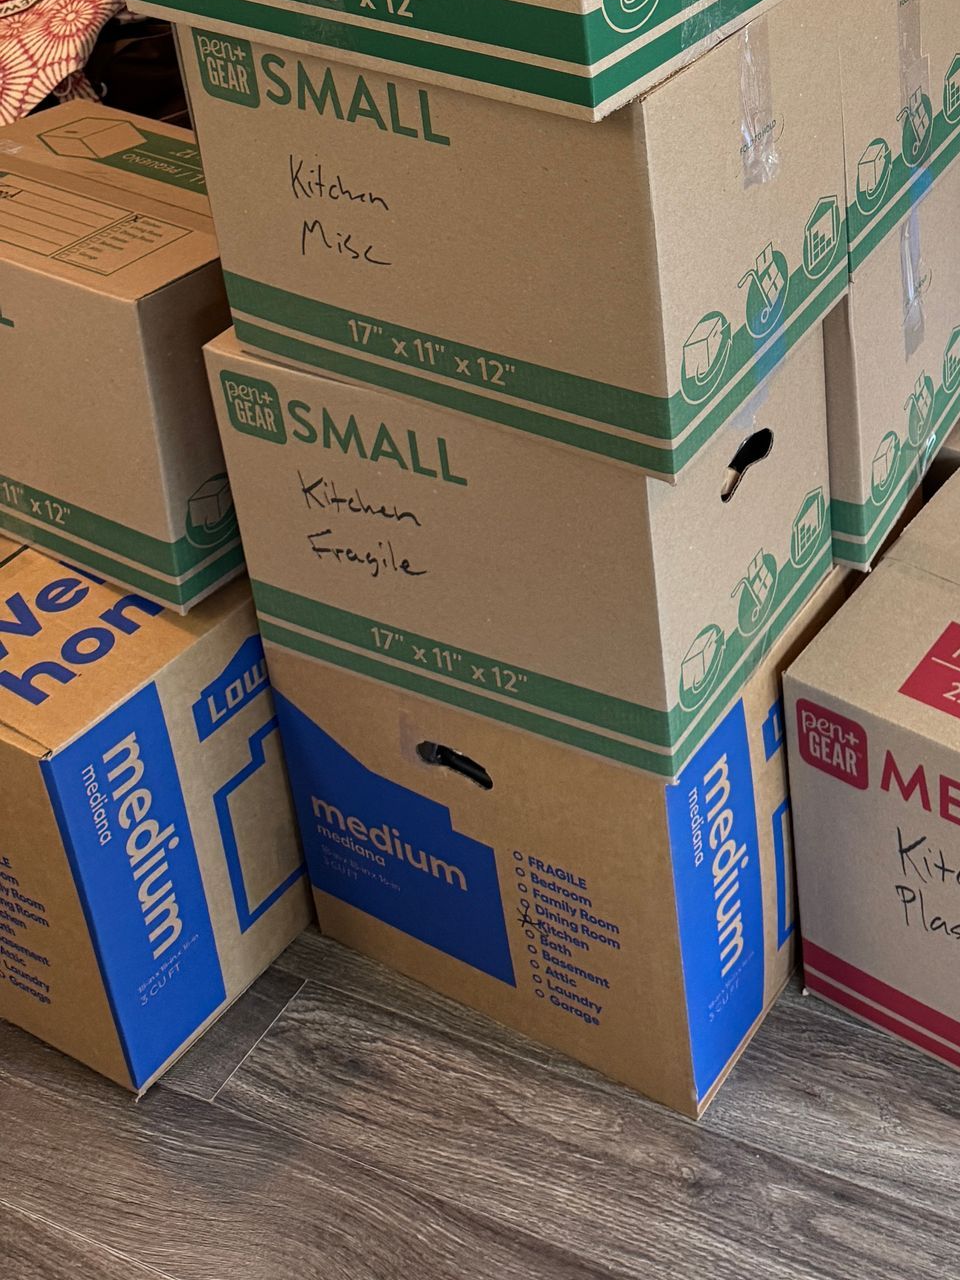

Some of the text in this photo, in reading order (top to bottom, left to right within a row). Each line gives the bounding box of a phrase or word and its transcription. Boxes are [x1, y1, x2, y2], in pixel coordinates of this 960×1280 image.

[196, 35, 246, 62] pen+
[206, 56, 251, 95] GEAR
[260, 53, 450, 146] SMALL
[289, 154, 389, 211] Kitchen
[301, 219, 392, 266] Misc
[348, 318, 516, 386] 17" x 11" x 12"
[225, 379, 274, 405] pen+
[234, 398, 278, 433] GEAR
[287, 399, 468, 487] SMALL
[44, 499, 71, 525] 12"
[297, 469, 422, 527] Kitchen
[306, 528, 428, 578] Fragile
[370, 626, 528, 694] 17" x 11" x 12"
[800, 708, 860, 748] pen+
[808, 730, 859, 776] GEAR
[81, 763, 113, 847] mediana
[102, 731, 183, 961] medium
[311, 795, 469, 892] medium
[317, 823, 386, 867] mediana
[688, 786, 705, 869] mediana
[528, 855, 588, 891] FRAGILE
[703, 752, 750, 978] medium
[11, 887, 46, 913] Room
[530, 872, 593, 908] Bedroom
[15, 902, 50, 928] Room
[533, 887, 620, 935] Family Room
[535, 903, 621, 950] Dining Room
[0, 935, 51, 968] asement
[536, 918, 590, 952] Kitchen
[540, 934, 573, 958] Bath
[3, 959, 51, 993] Laundry
[9, 974, 52, 1005] Garage
[149, 975, 167, 998] CU
[542, 949, 611, 990] Basement
[545, 965, 578, 988] Attic
[546, 978, 603, 1015] Laundry
[549, 994, 601, 1026] Garage
